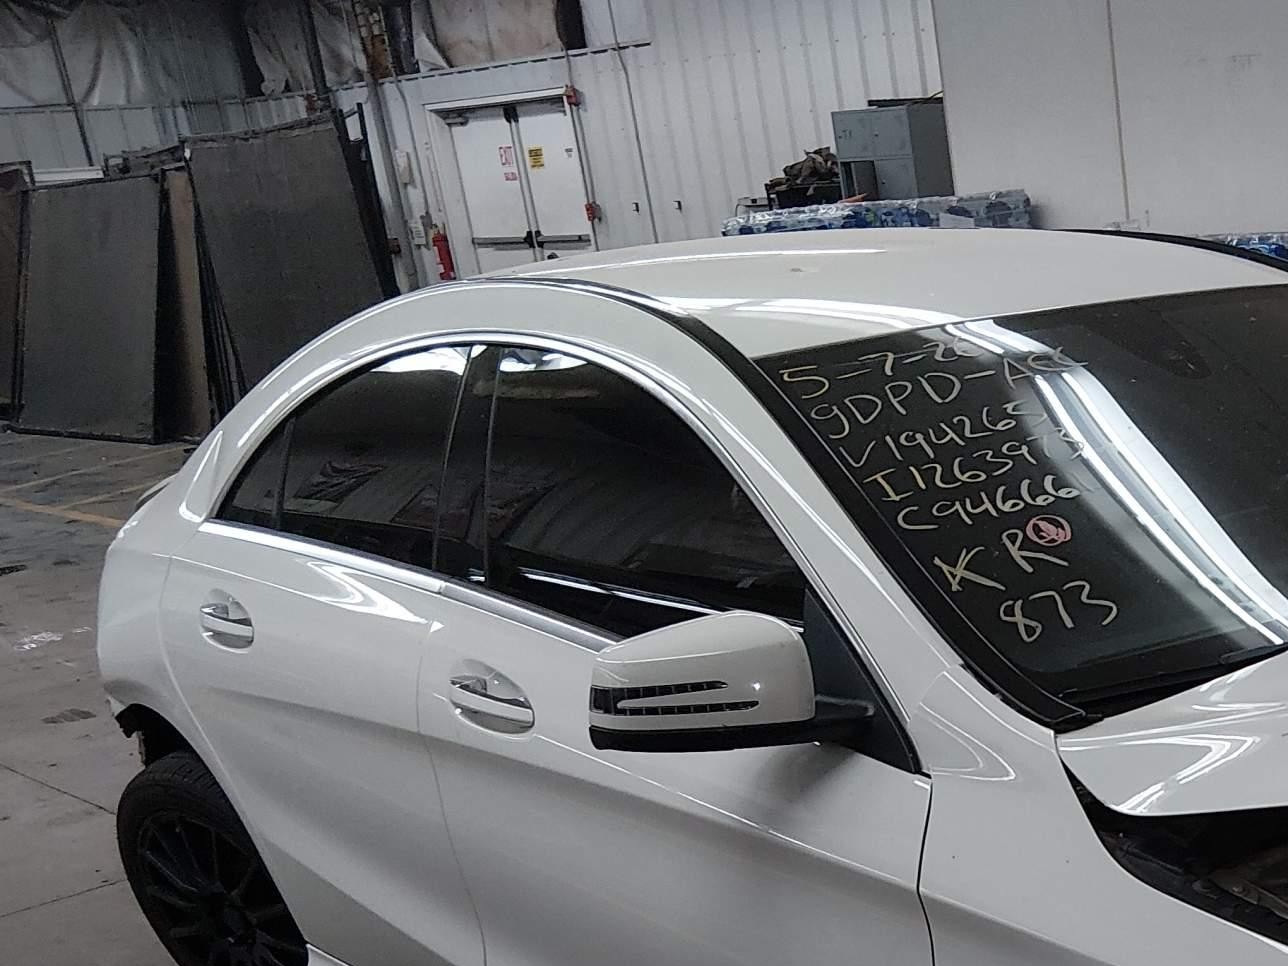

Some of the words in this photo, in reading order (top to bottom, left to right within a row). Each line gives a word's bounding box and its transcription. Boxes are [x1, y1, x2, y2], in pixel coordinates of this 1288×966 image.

[780, 336, 983, 399] 5-7-26
[839, 399, 1048, 468] V194265
[1000, 581, 1118, 642] 873
